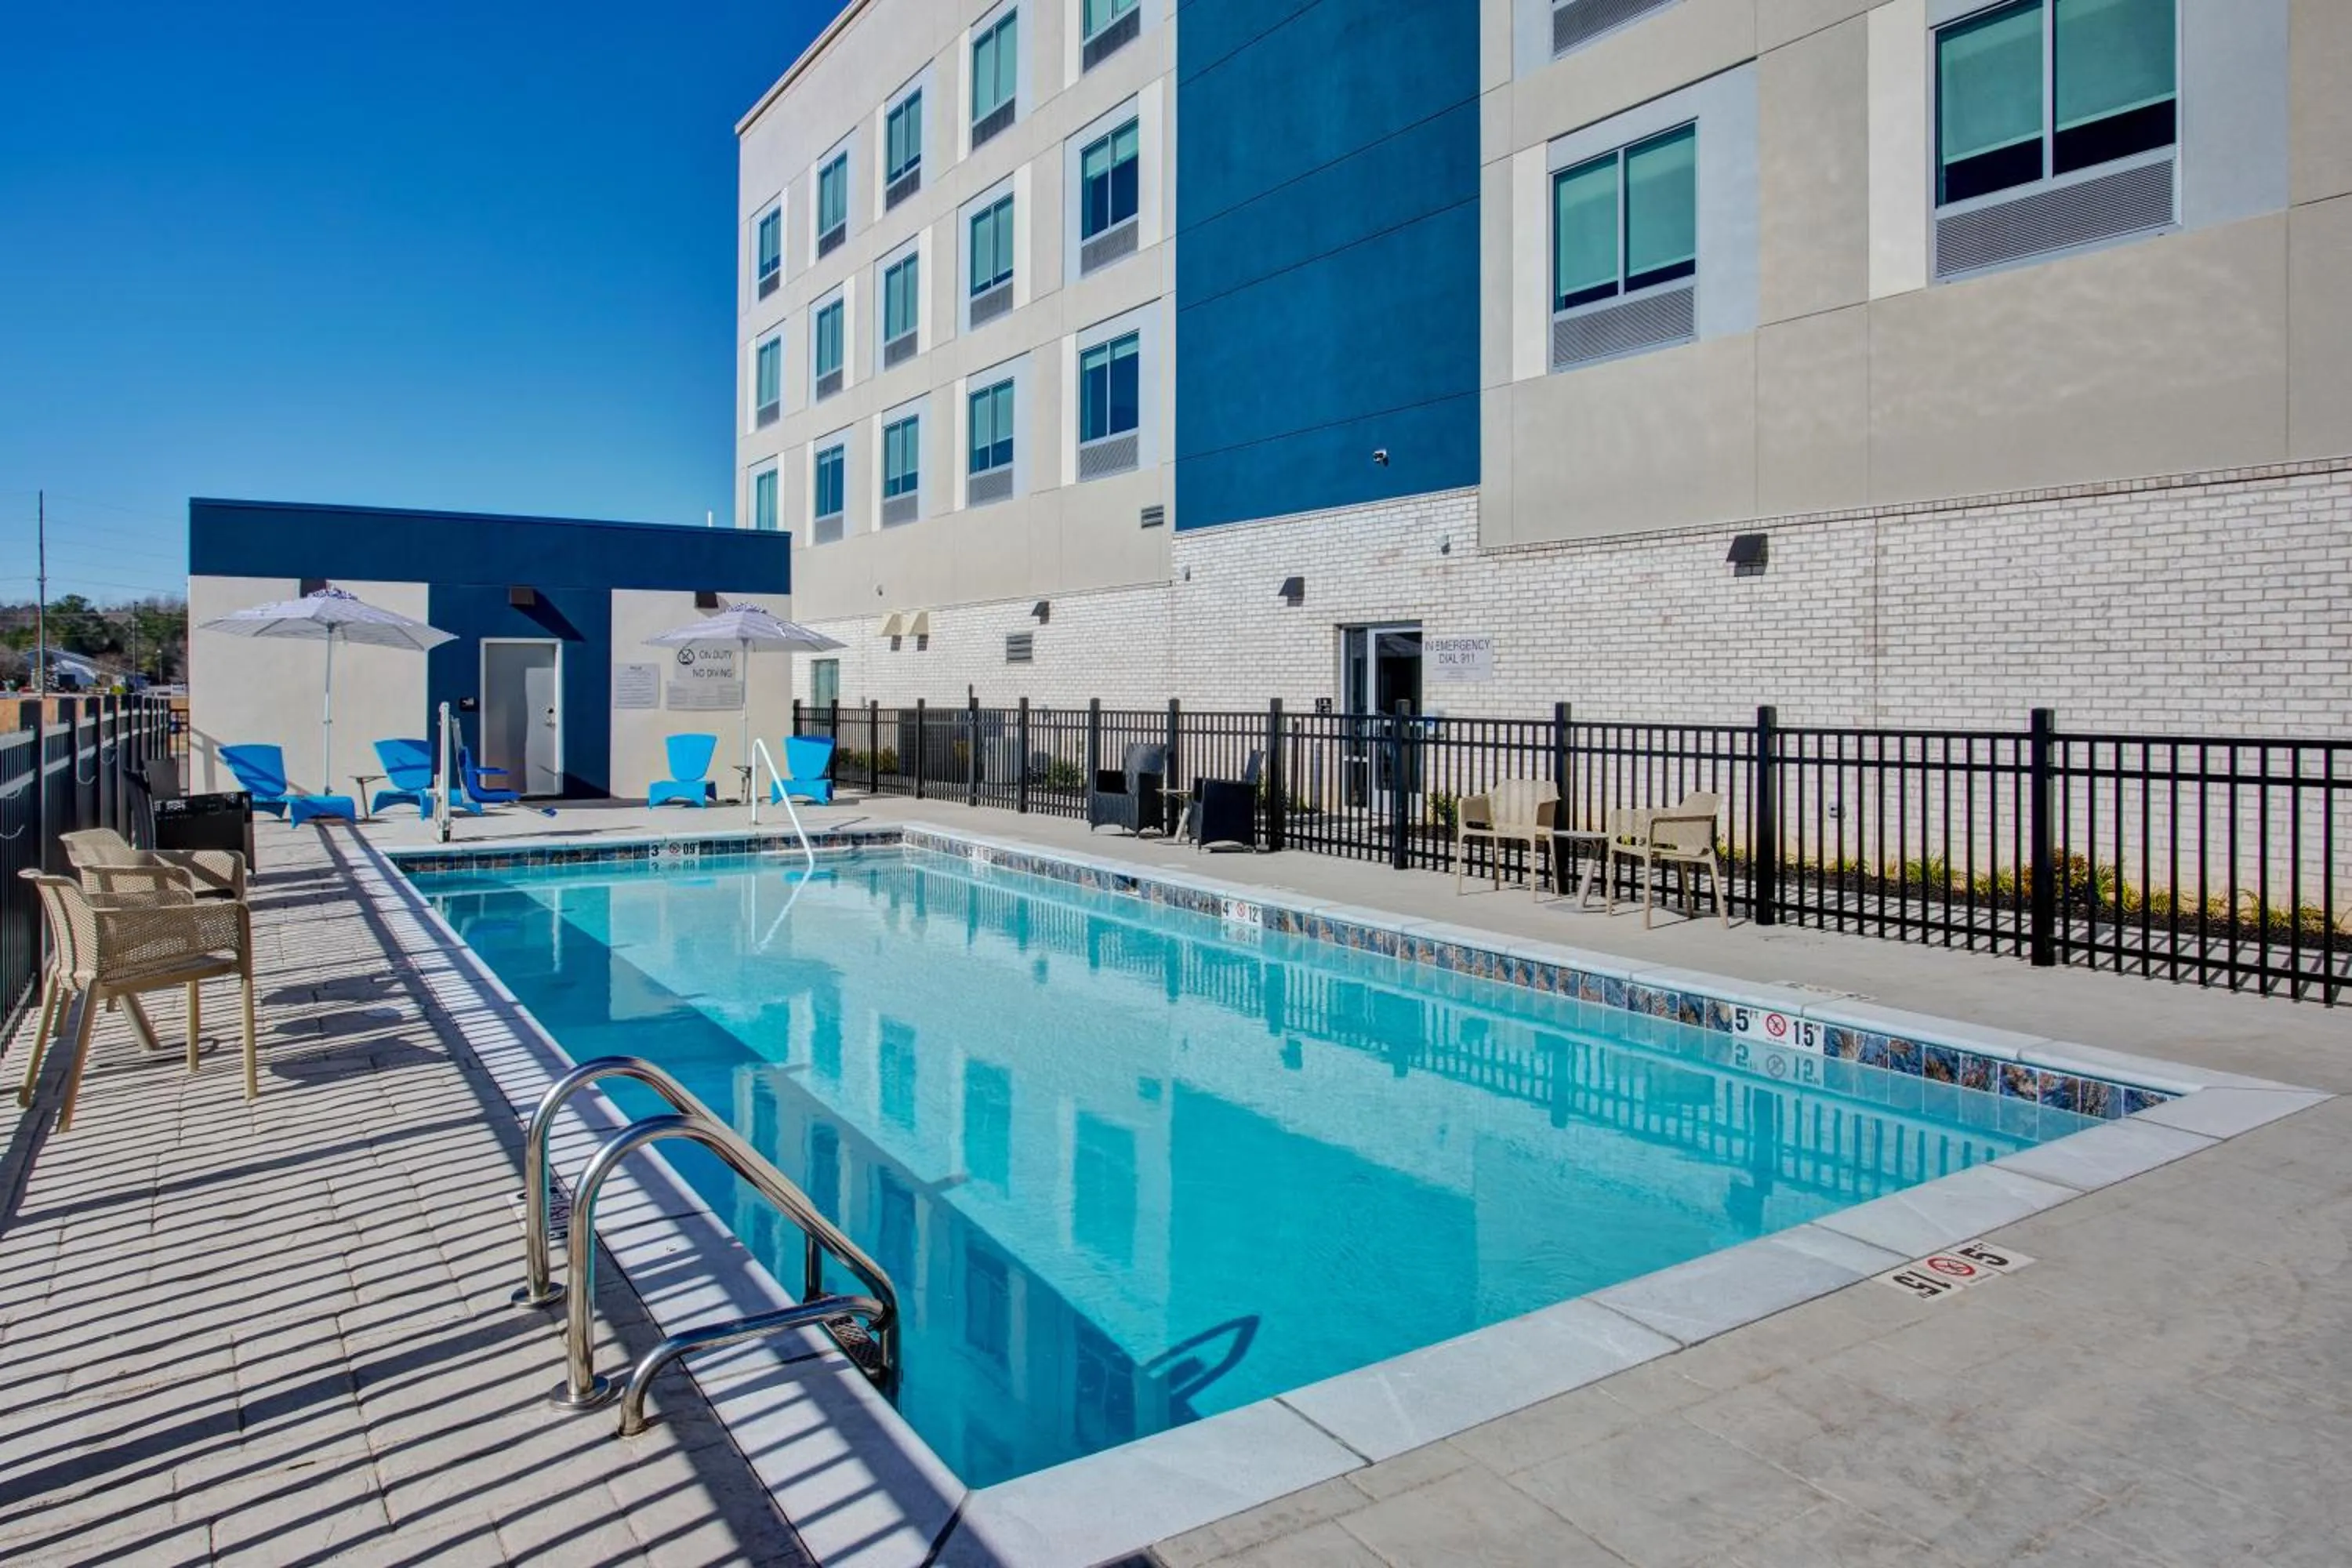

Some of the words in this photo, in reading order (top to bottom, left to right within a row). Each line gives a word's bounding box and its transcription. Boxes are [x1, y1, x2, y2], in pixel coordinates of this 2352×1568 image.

[1436, 639, 1490, 652] EMERGENCY
[1439, 652, 1459, 664] DIAL
[692, 668, 705, 678] NO
[651, 844, 659, 857] 3
[1222, 900, 1229, 916] 4
[1735, 1007, 1749, 1033] 5
